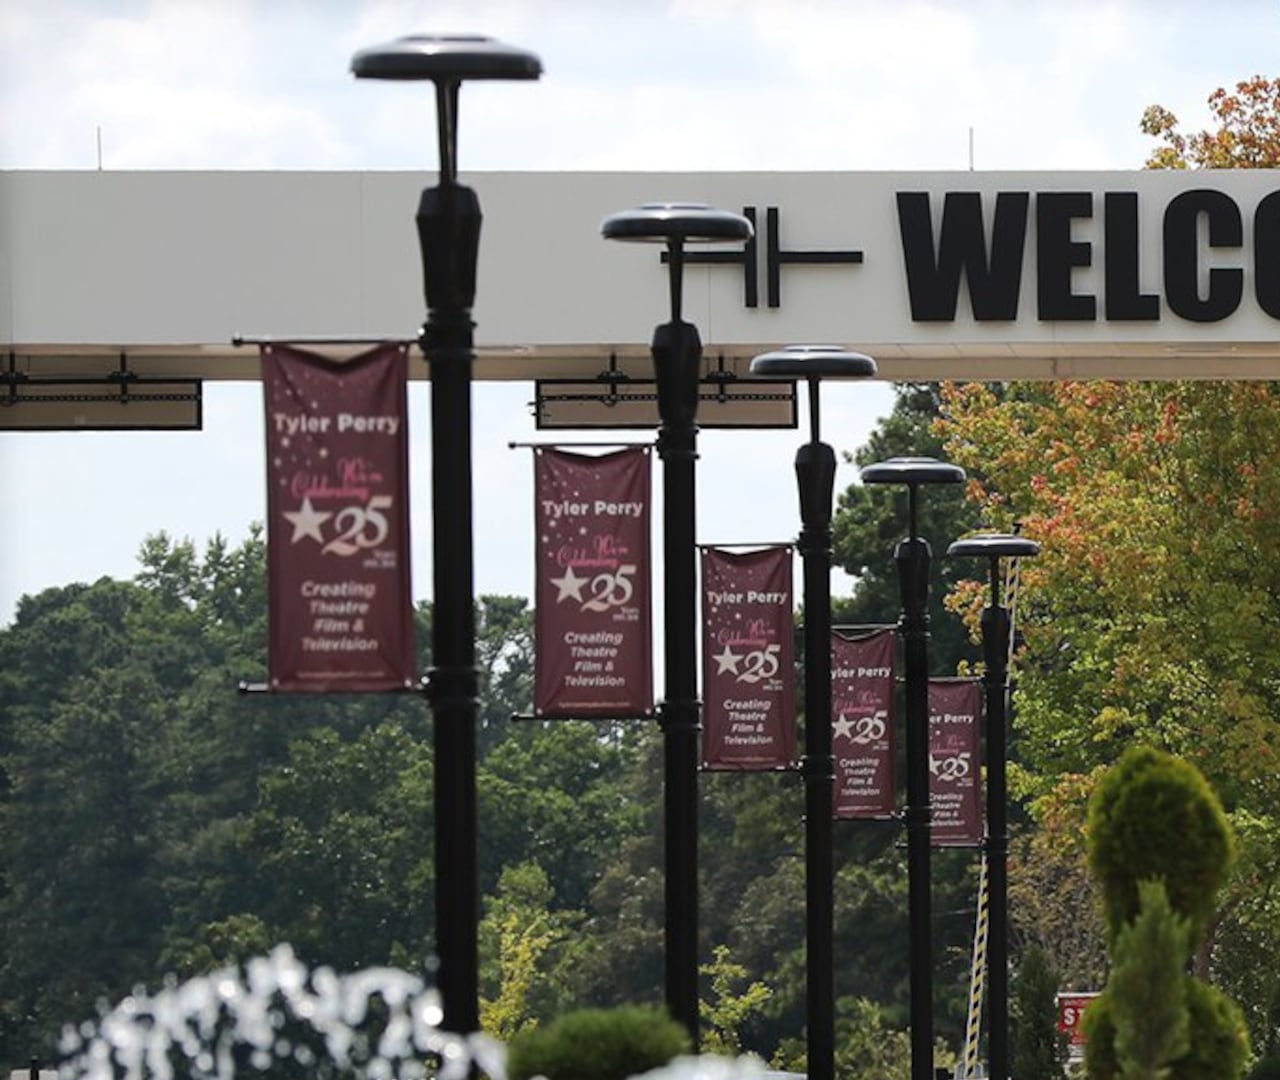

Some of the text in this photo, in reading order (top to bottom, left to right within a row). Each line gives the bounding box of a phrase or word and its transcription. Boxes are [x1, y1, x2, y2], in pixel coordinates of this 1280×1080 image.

[273, 413, 399, 435] Tyler Perry
[542, 500, 643, 518] Tyler Perry
[321, 496, 393, 556] 25
[301, 581, 376, 599] Creating
[580, 564, 636, 612] 25
[707, 590, 788, 605] Tyler Perry
[310, 601, 369, 614] Theatre
[313, 619, 349, 632] Film
[302, 637, 378, 650] Television
[564, 631, 623, 645] Creating
[571, 647, 618, 658] Theatre
[574, 661, 602, 672] Film
[736, 644, 781, 684] 25
[830, 667, 891, 680] yler Perry
[565, 675, 625, 687] Television
[723, 699, 772, 711] Creating
[728, 711, 767, 721] Theatre
[944, 713, 974, 724] Perry
[849, 710, 888, 745] 25
[937, 752, 971, 782] 25
